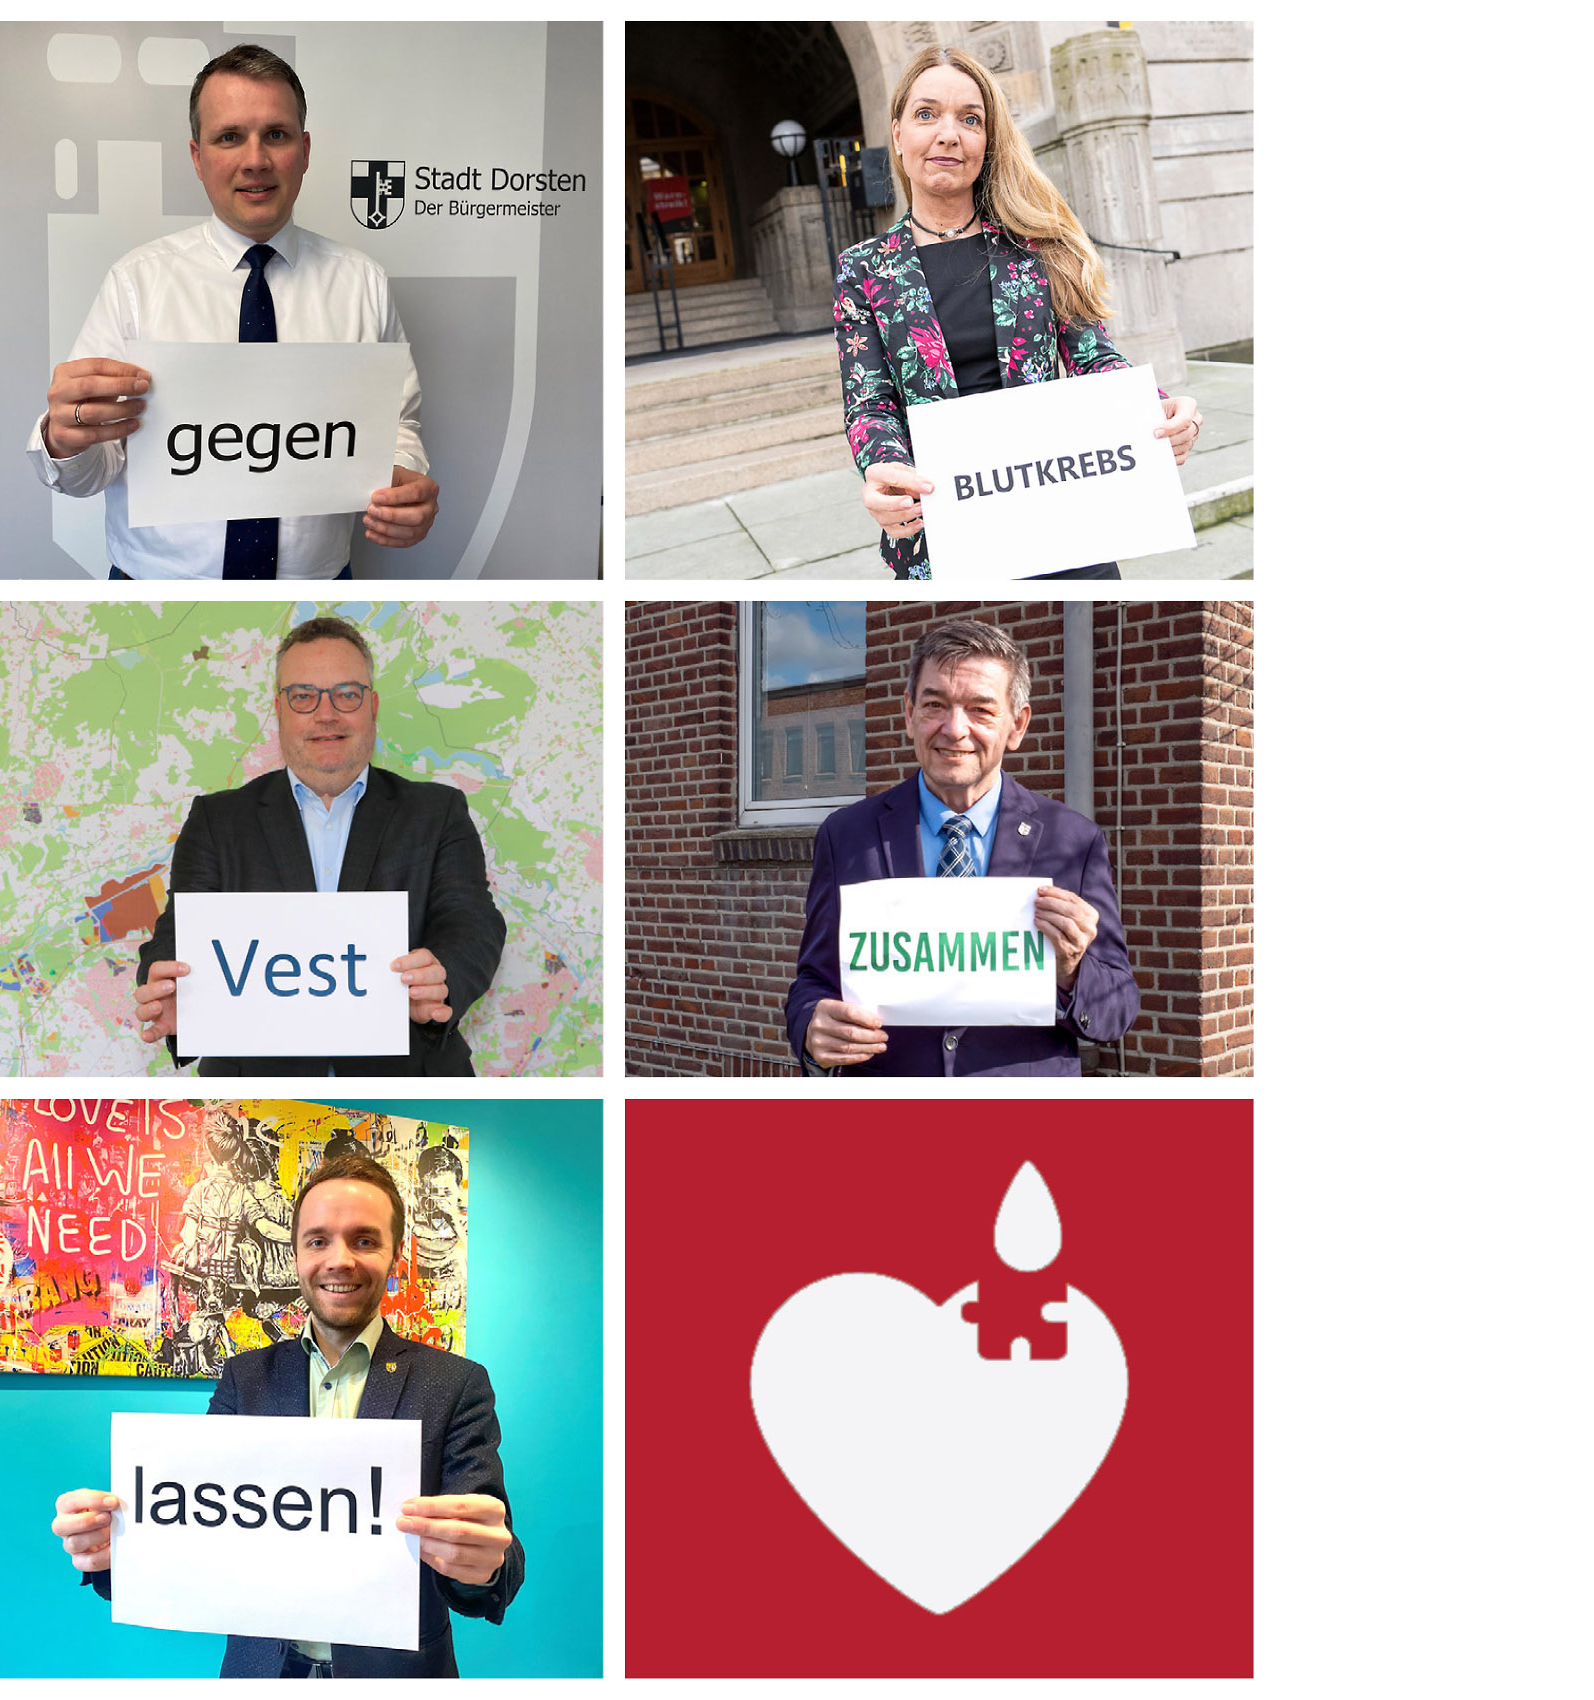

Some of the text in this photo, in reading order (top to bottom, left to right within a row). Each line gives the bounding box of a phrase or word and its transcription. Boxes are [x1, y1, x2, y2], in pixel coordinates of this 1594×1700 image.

[415, 166, 587, 192] Stadt Dorsten
[414, 200, 561, 219] Der Bürgermeister
[167, 420, 356, 476] gegen
[953, 444, 1137, 502] BLUTKREBS
[211, 939, 368, 998] Vest
[849, 930, 1045, 973] ZUSAMMEN
[145, 1099, 186, 1140] IS
[86, 1144, 166, 1198] WE
[27, 1205, 147, 1262] NEED
[135, 1465, 383, 1536] lassen!
